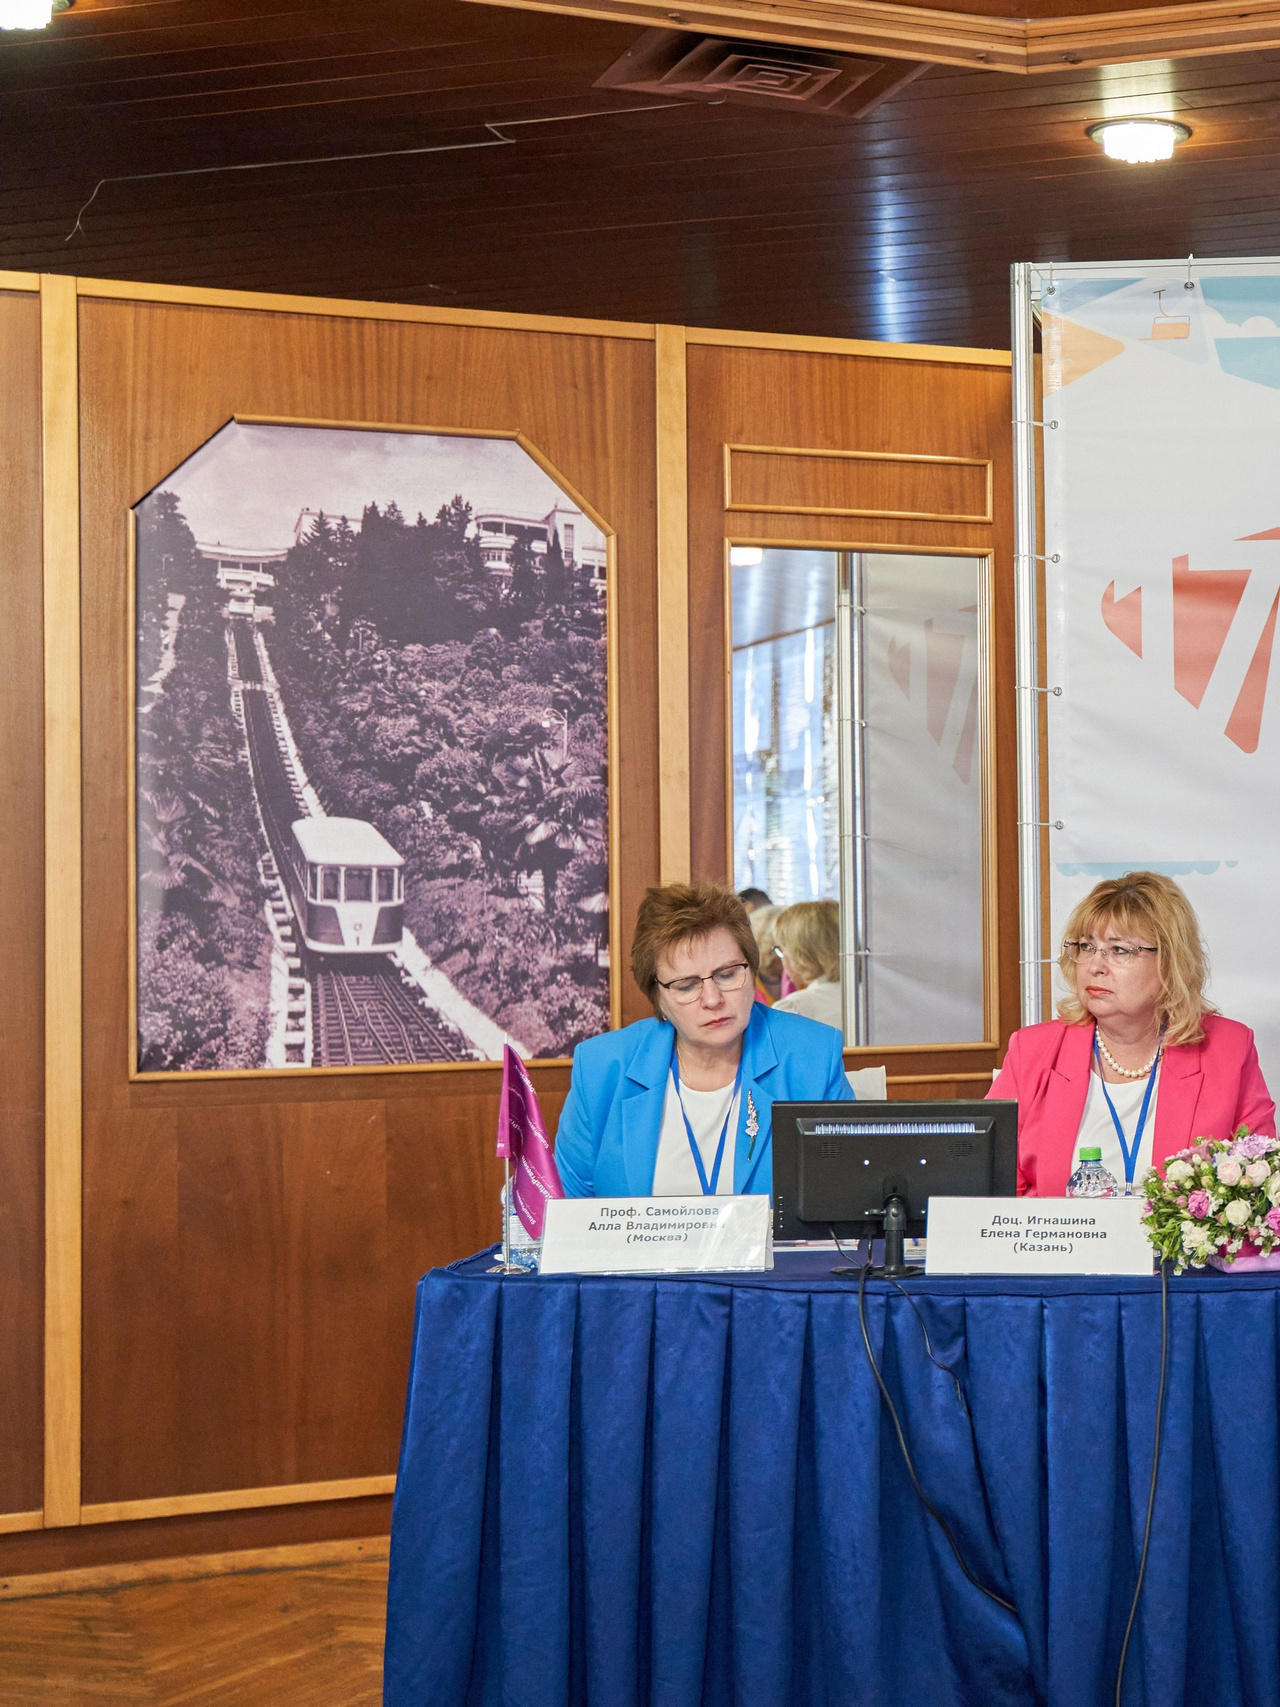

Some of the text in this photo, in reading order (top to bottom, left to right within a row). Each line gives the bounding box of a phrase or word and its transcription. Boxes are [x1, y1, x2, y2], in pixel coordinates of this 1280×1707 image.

[600, 1206, 719, 1219] Проф. Самойлова
[588, 1222, 725, 1231] Алла Владимировн
[992, 1215, 1096, 1227] Доц. Игнашина
[626, 1233, 688, 1244] (Москва)
[981, 1229, 1107, 1240] Елена Германовна
[1013, 1242, 1073, 1253] (Казань)
